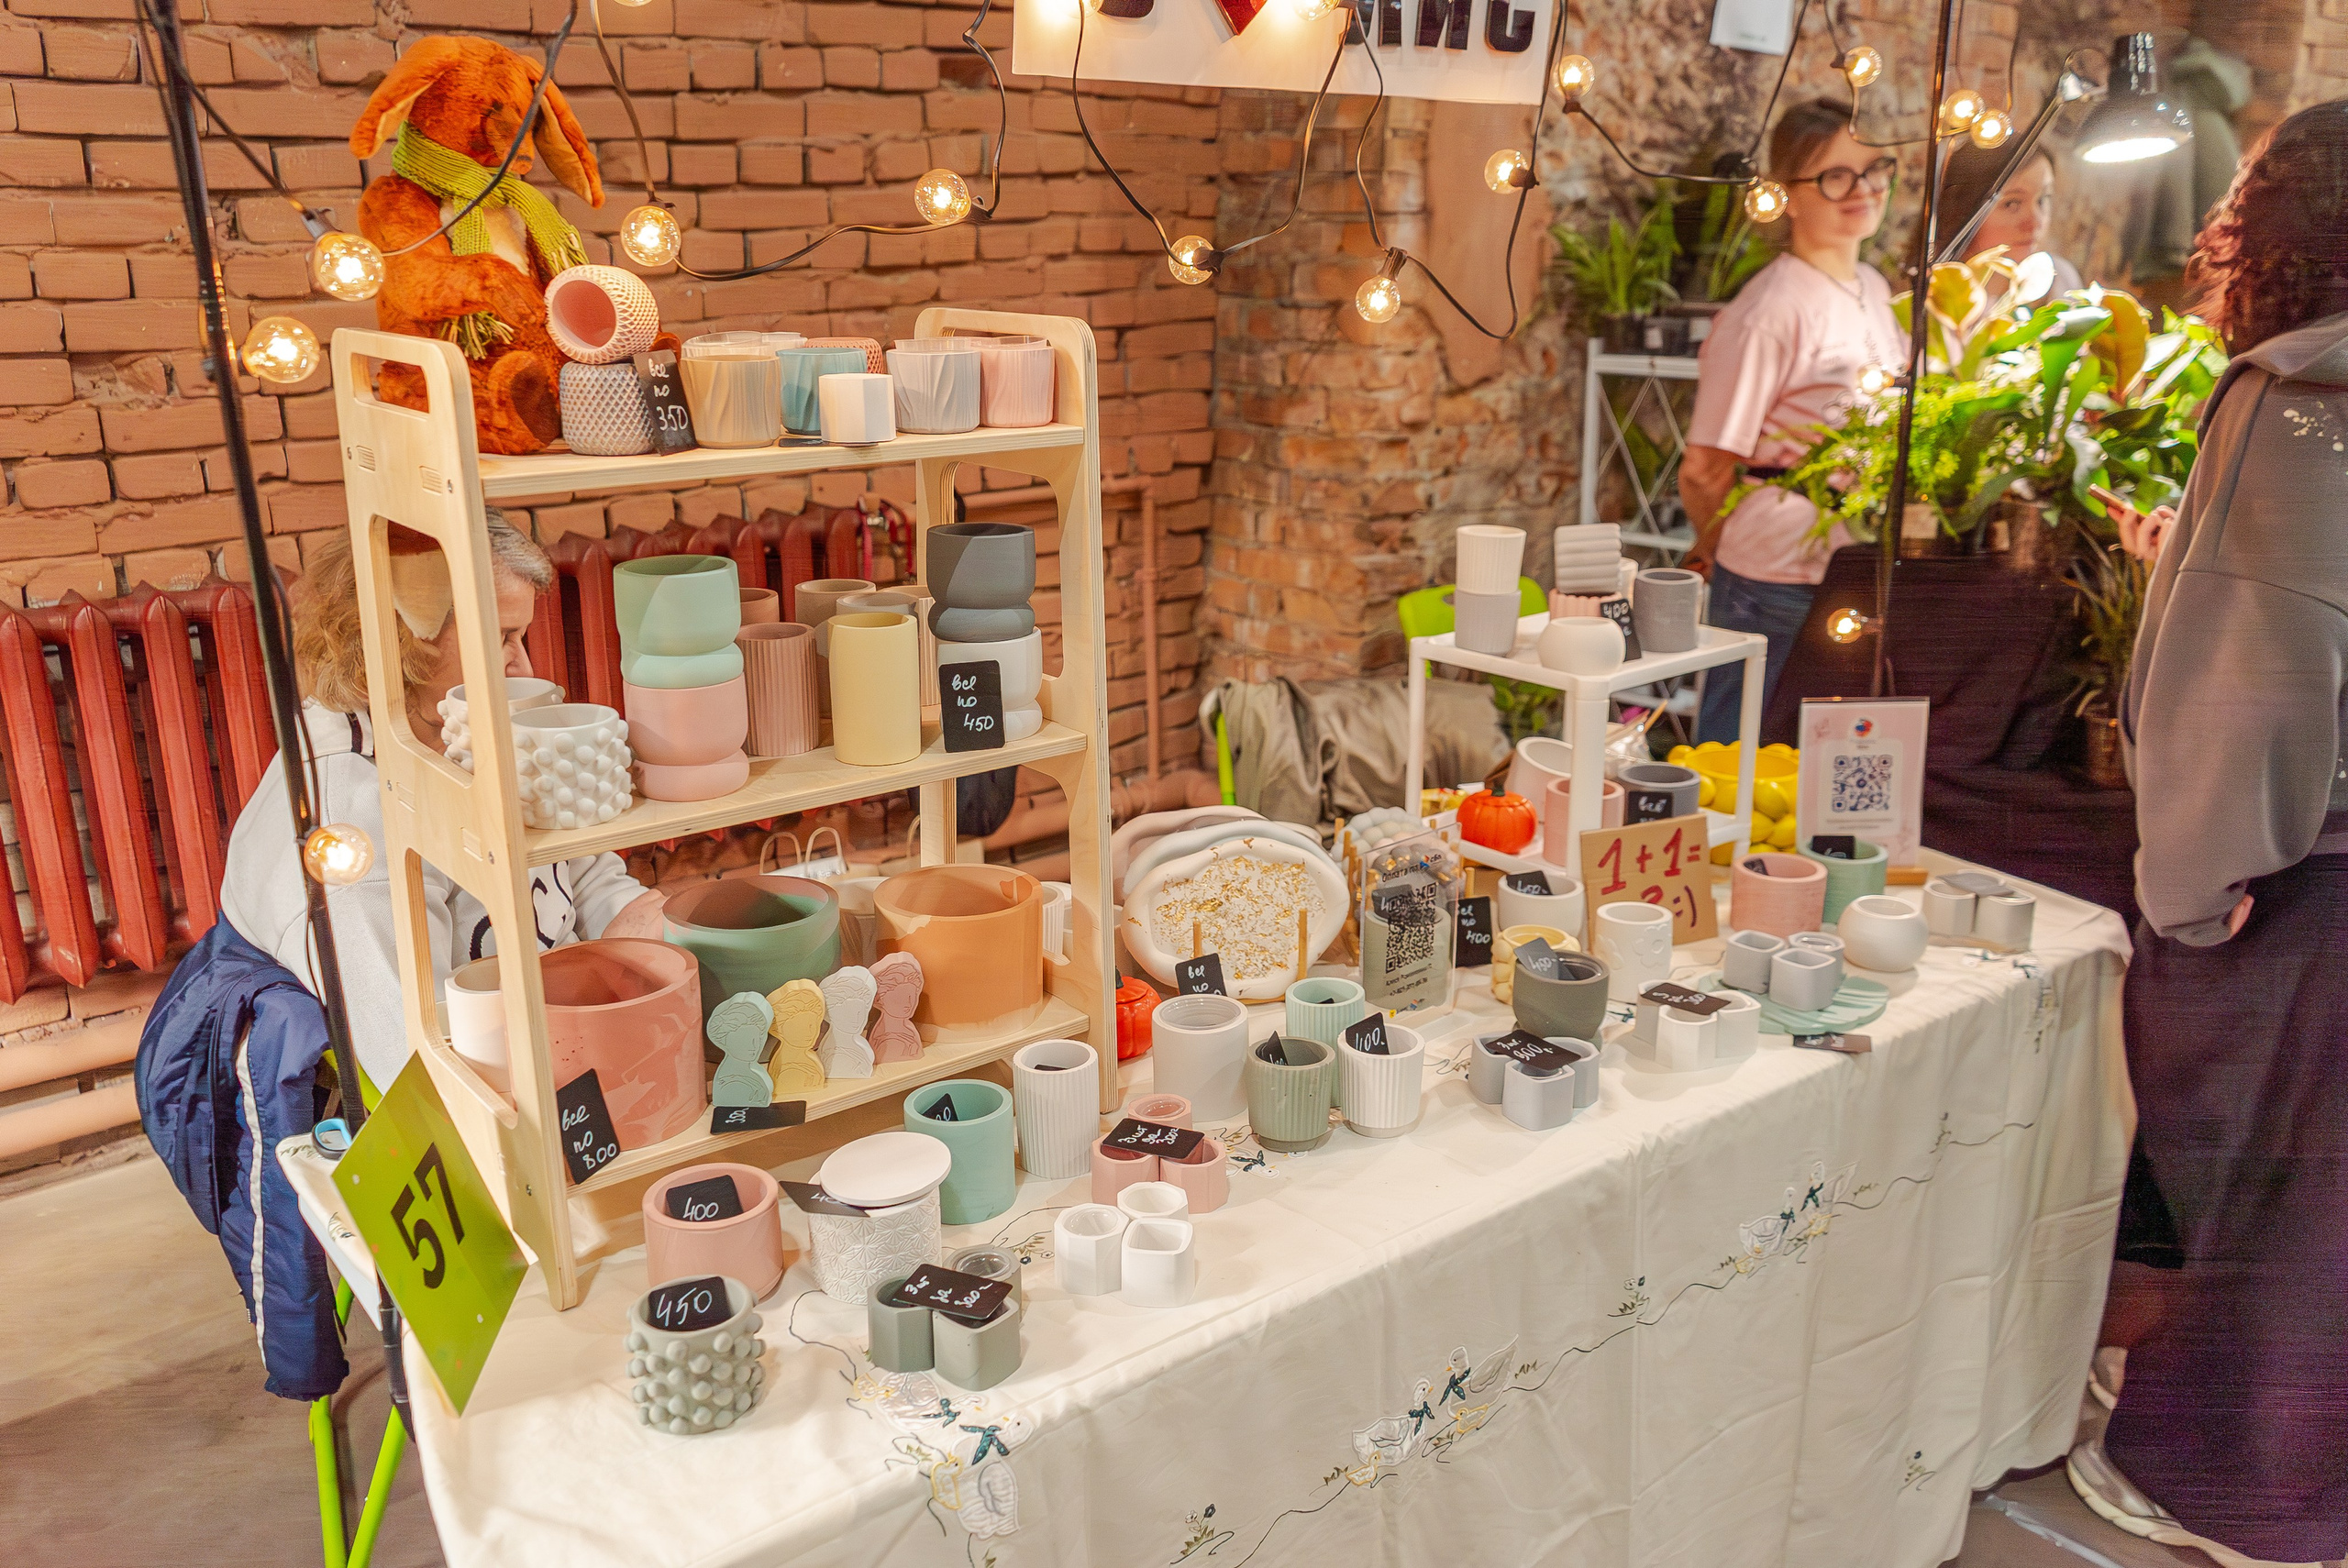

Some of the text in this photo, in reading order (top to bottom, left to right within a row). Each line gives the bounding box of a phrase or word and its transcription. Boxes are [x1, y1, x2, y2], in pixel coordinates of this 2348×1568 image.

[656, 404, 689, 431] 350
[963, 712, 994, 732] 450
[1466, 930, 1491, 944] 400
[582, 1143, 617, 1170] 800
[390, 1142, 465, 1289] 57
[682, 1197, 719, 1221] 400
[656, 1286, 713, 1327] 450
